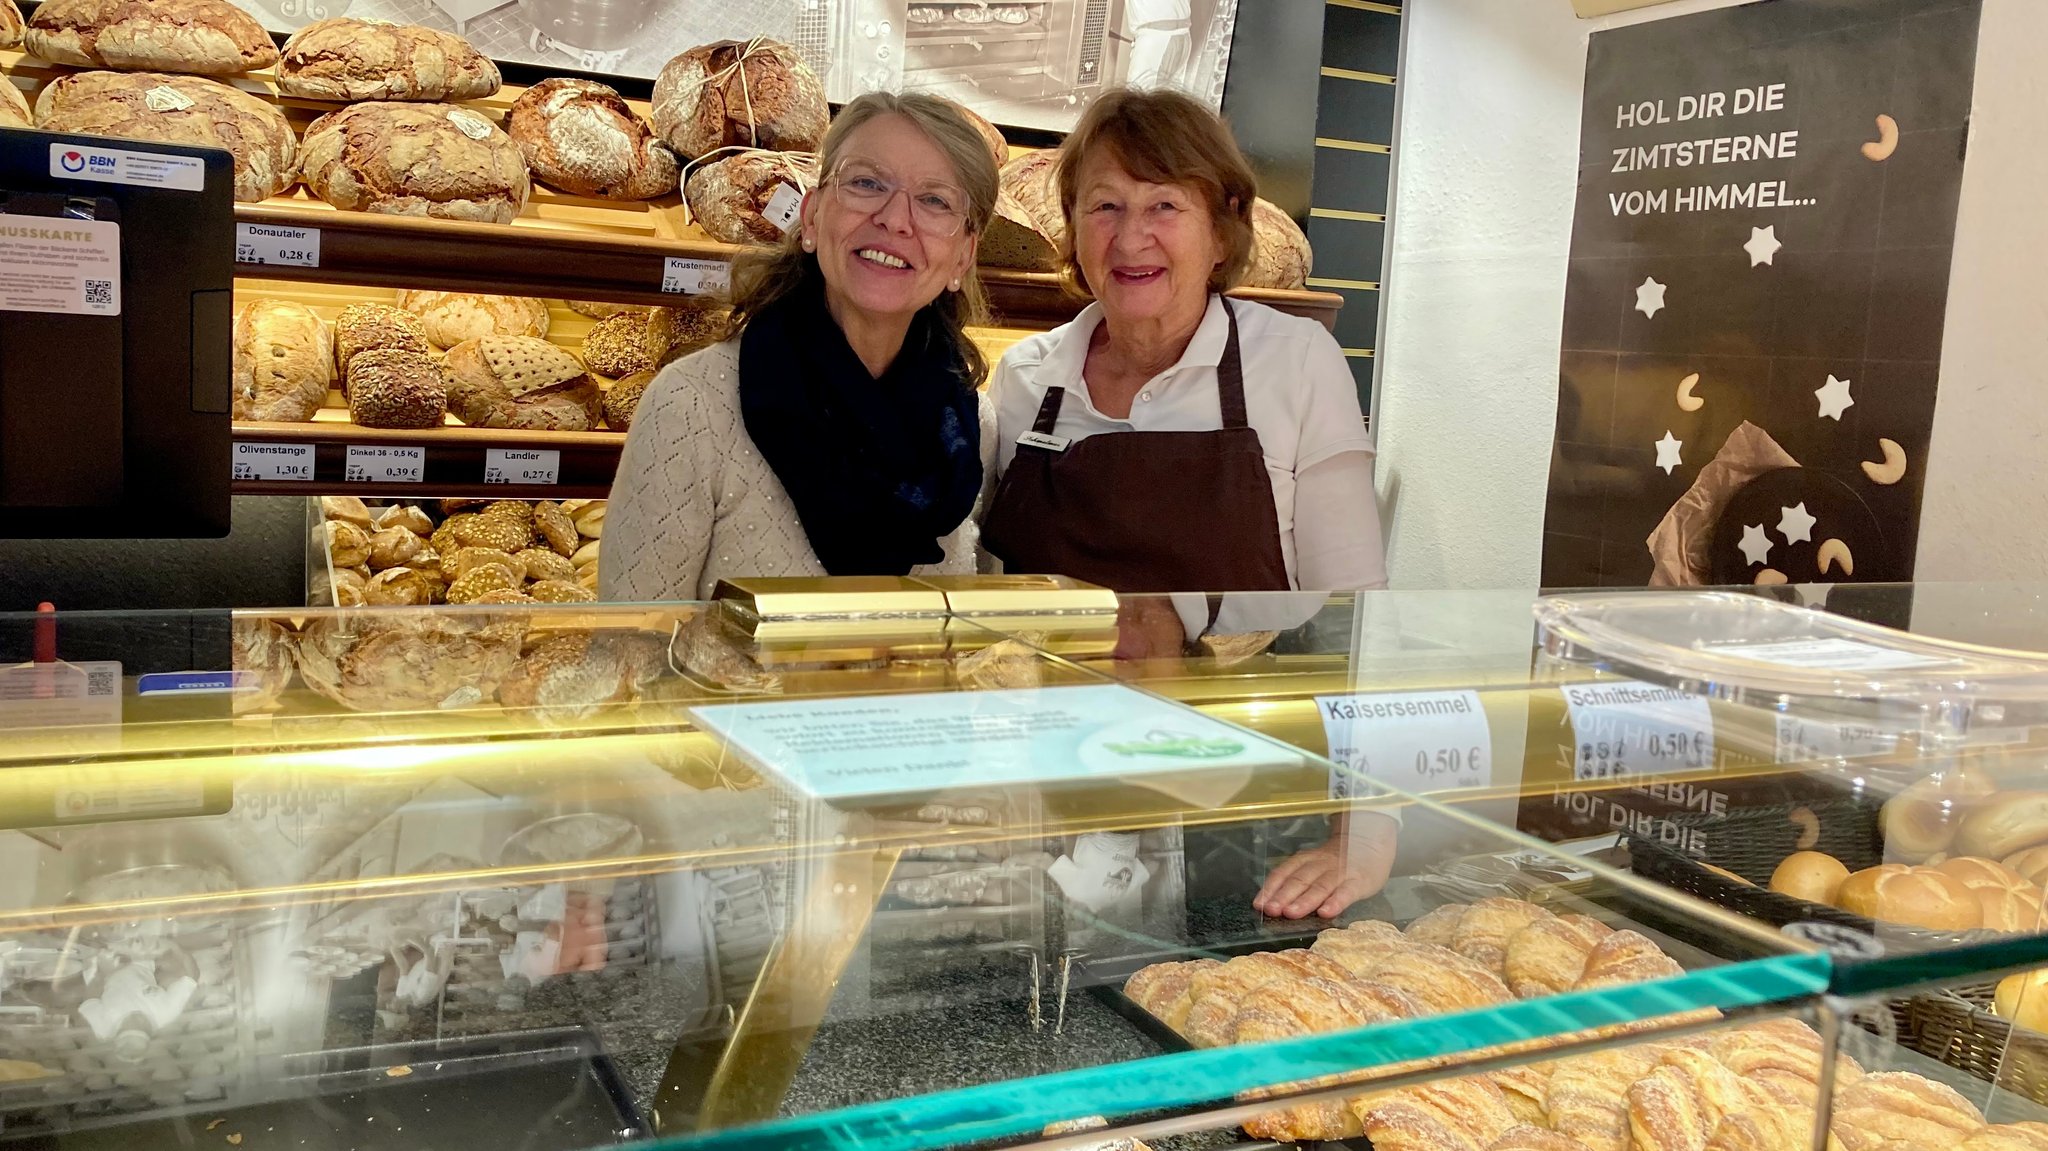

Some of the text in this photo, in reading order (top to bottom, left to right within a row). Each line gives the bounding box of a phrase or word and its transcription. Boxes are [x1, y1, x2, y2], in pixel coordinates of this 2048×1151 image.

[1616, 83, 1786, 129] HOL DIR DIE
[1611, 130, 1799, 173] ZIMTSTERNE
[89, 155, 116, 168] BBN
[90, 166, 115, 176] Kasse
[1609, 180, 1817, 216] VOM HIMMEL...
[249, 226, 306, 239] Donautaler
[279, 249, 313, 261] 0,28 €
[239, 445, 306, 456] Olivenstange
[350, 448, 376, 456] Dinkel
[393, 450, 406, 458] 0,5
[407, 450, 419, 459] Kg
[505, 451, 540, 460] Landler
[275, 465, 309, 475] 1,30 €
[386, 467, 418, 477] 0,39 €
[523, 470, 553, 479] 0,27 €
[1326, 694, 1472, 720] Kaisersemmel
[1650, 732, 1688, 758] 0,50
[1415, 746, 1481, 779] 0,50 €
